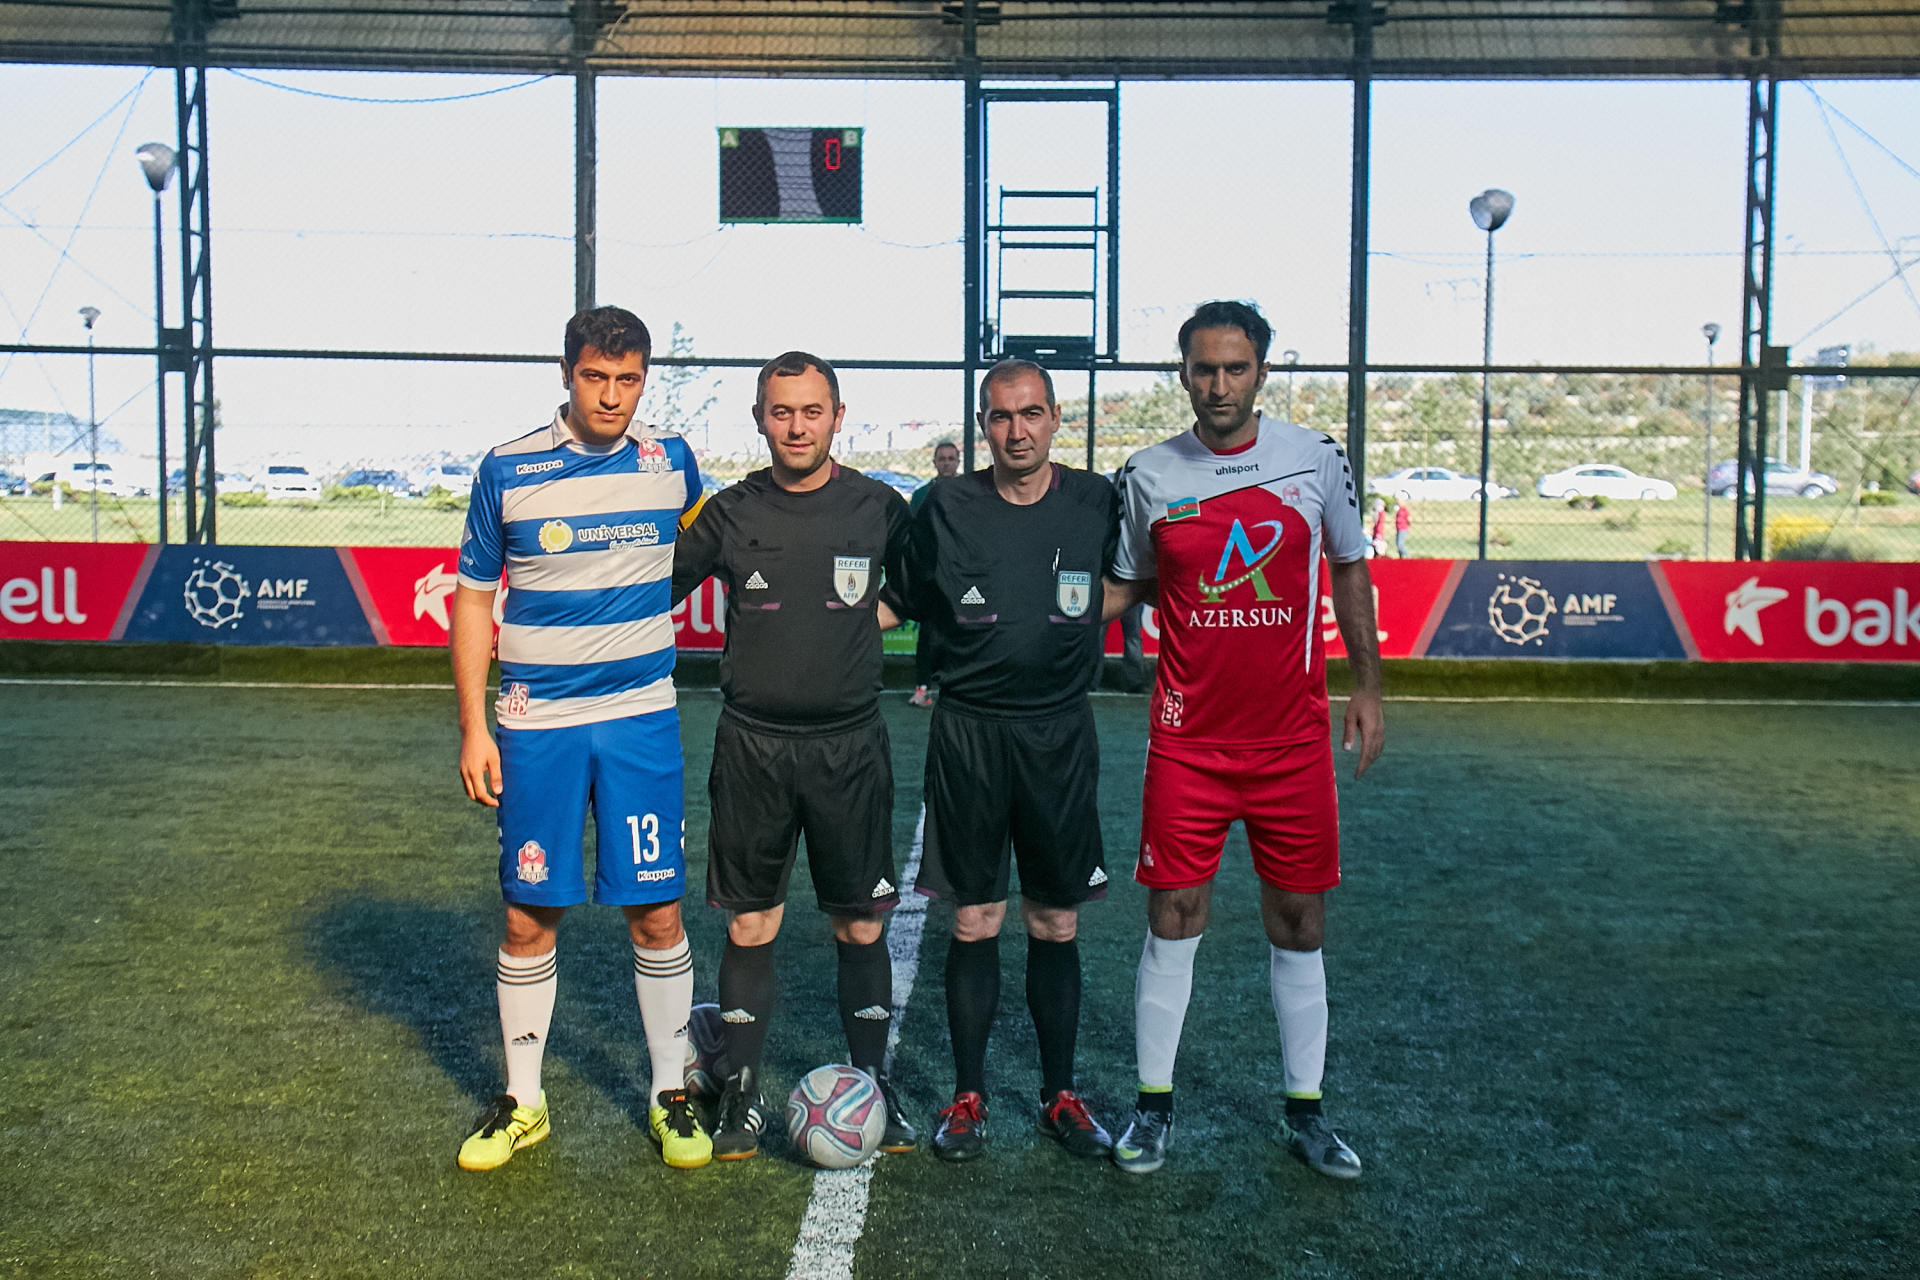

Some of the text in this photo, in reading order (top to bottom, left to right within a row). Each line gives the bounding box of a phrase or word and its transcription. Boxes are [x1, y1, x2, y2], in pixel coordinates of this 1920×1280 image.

[721, 131, 738, 145] A
[845, 131, 858, 145] B
[824, 138, 841, 170] 0
[517, 461, 563, 474] Kappa
[1216, 463, 1260, 476] uhlsport
[0, 566, 88, 625] ell
[257, 578, 309, 599] AMF
[1563, 593, 1617, 615] AMF
[1188, 607, 1293, 628] AZERSUN
[626, 813, 660, 865] 13
[637, 868, 675, 882] Kappa
